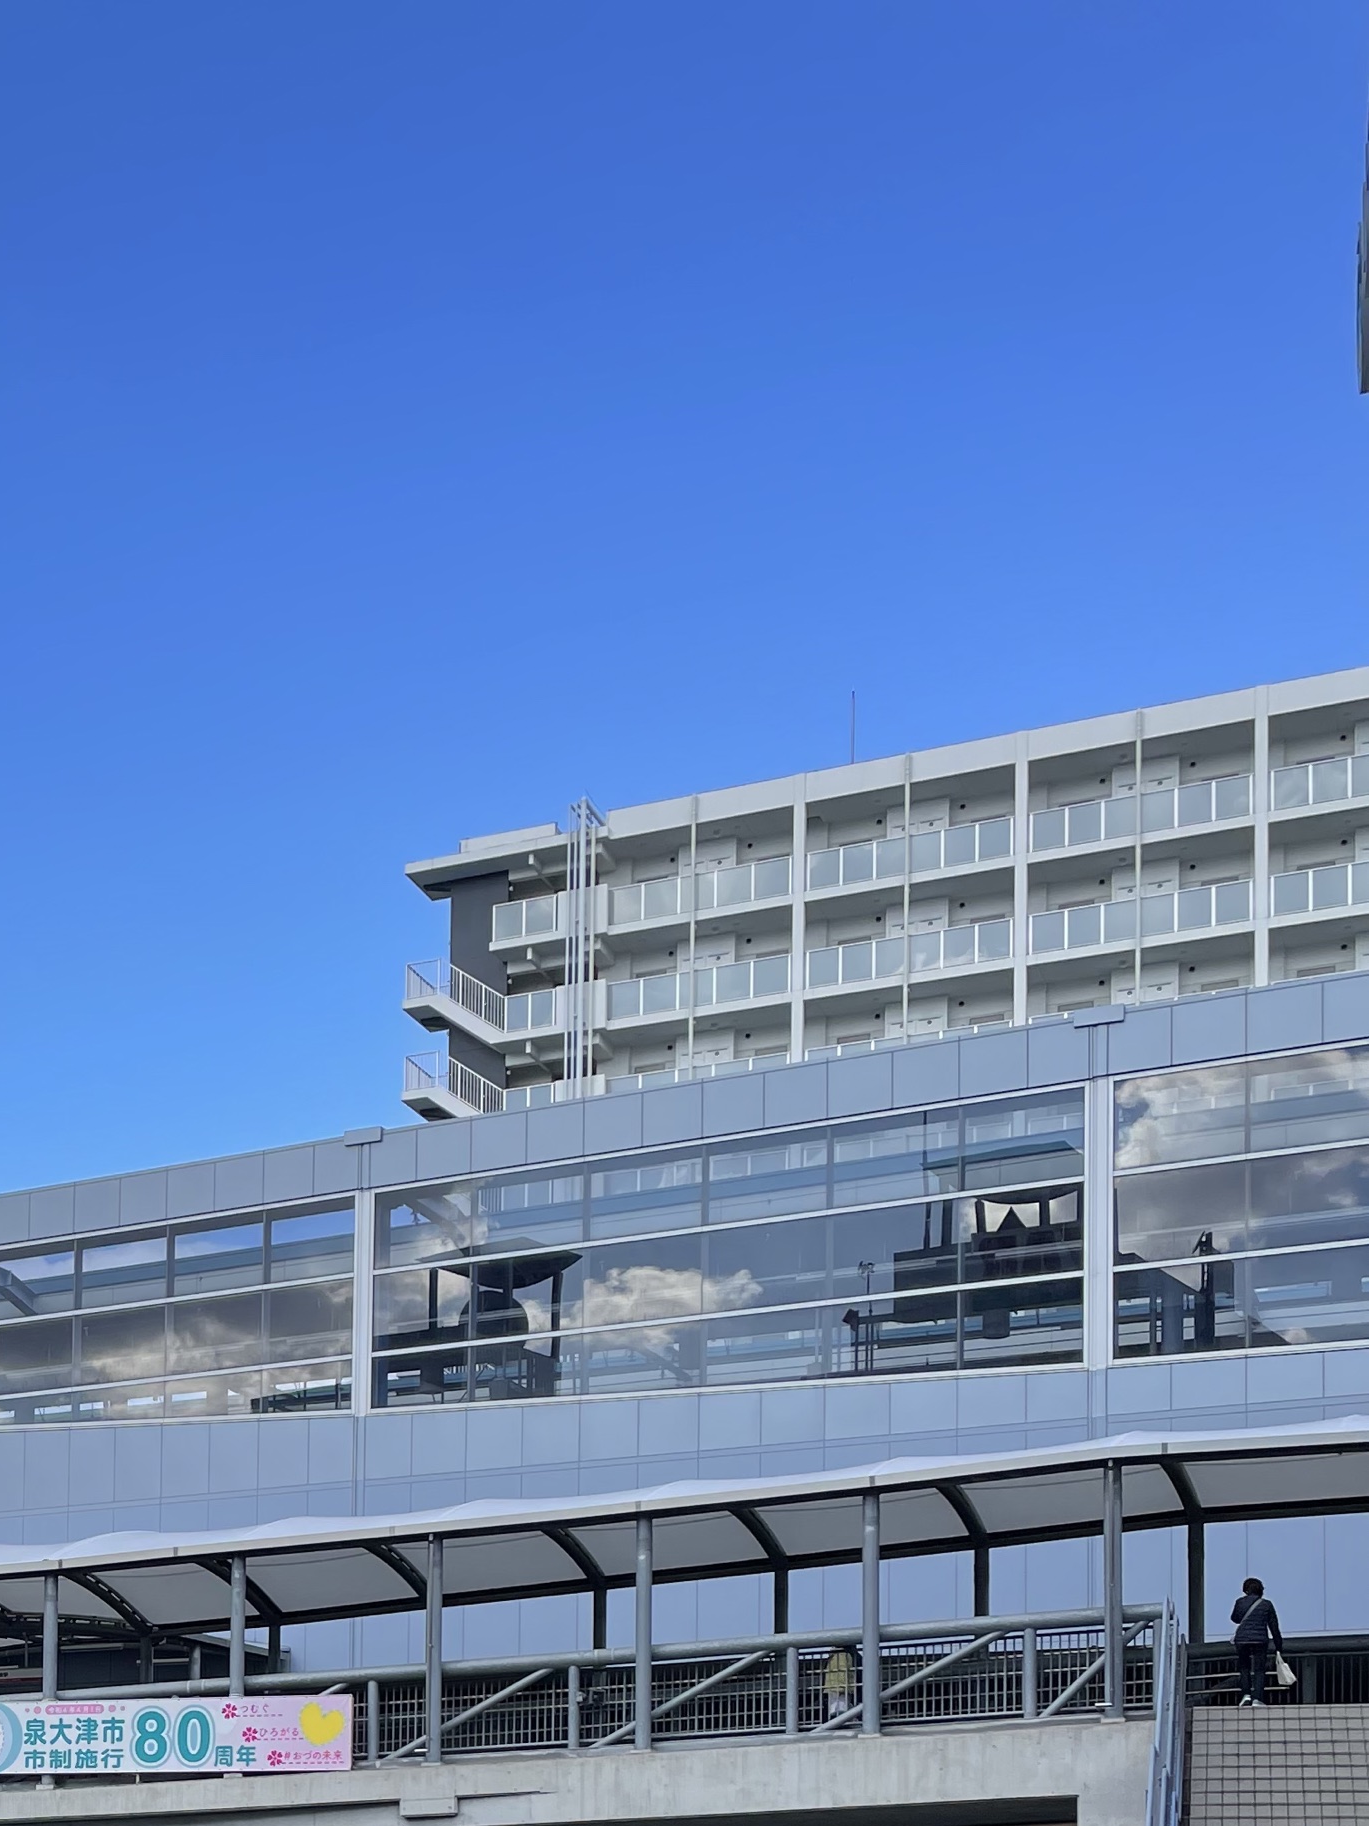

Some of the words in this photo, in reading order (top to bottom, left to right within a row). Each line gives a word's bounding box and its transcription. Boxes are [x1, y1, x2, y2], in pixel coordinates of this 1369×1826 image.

[240, 1704, 270, 1714] つむぐ
[23, 1716, 125, 1746] 泉大津市
[23, 1748, 125, 1769] 市制施行
[133, 1708, 213, 1765] 80
[214, 1745, 257, 1767] 周年
[259, 1727, 300, 1738] ひろがる
